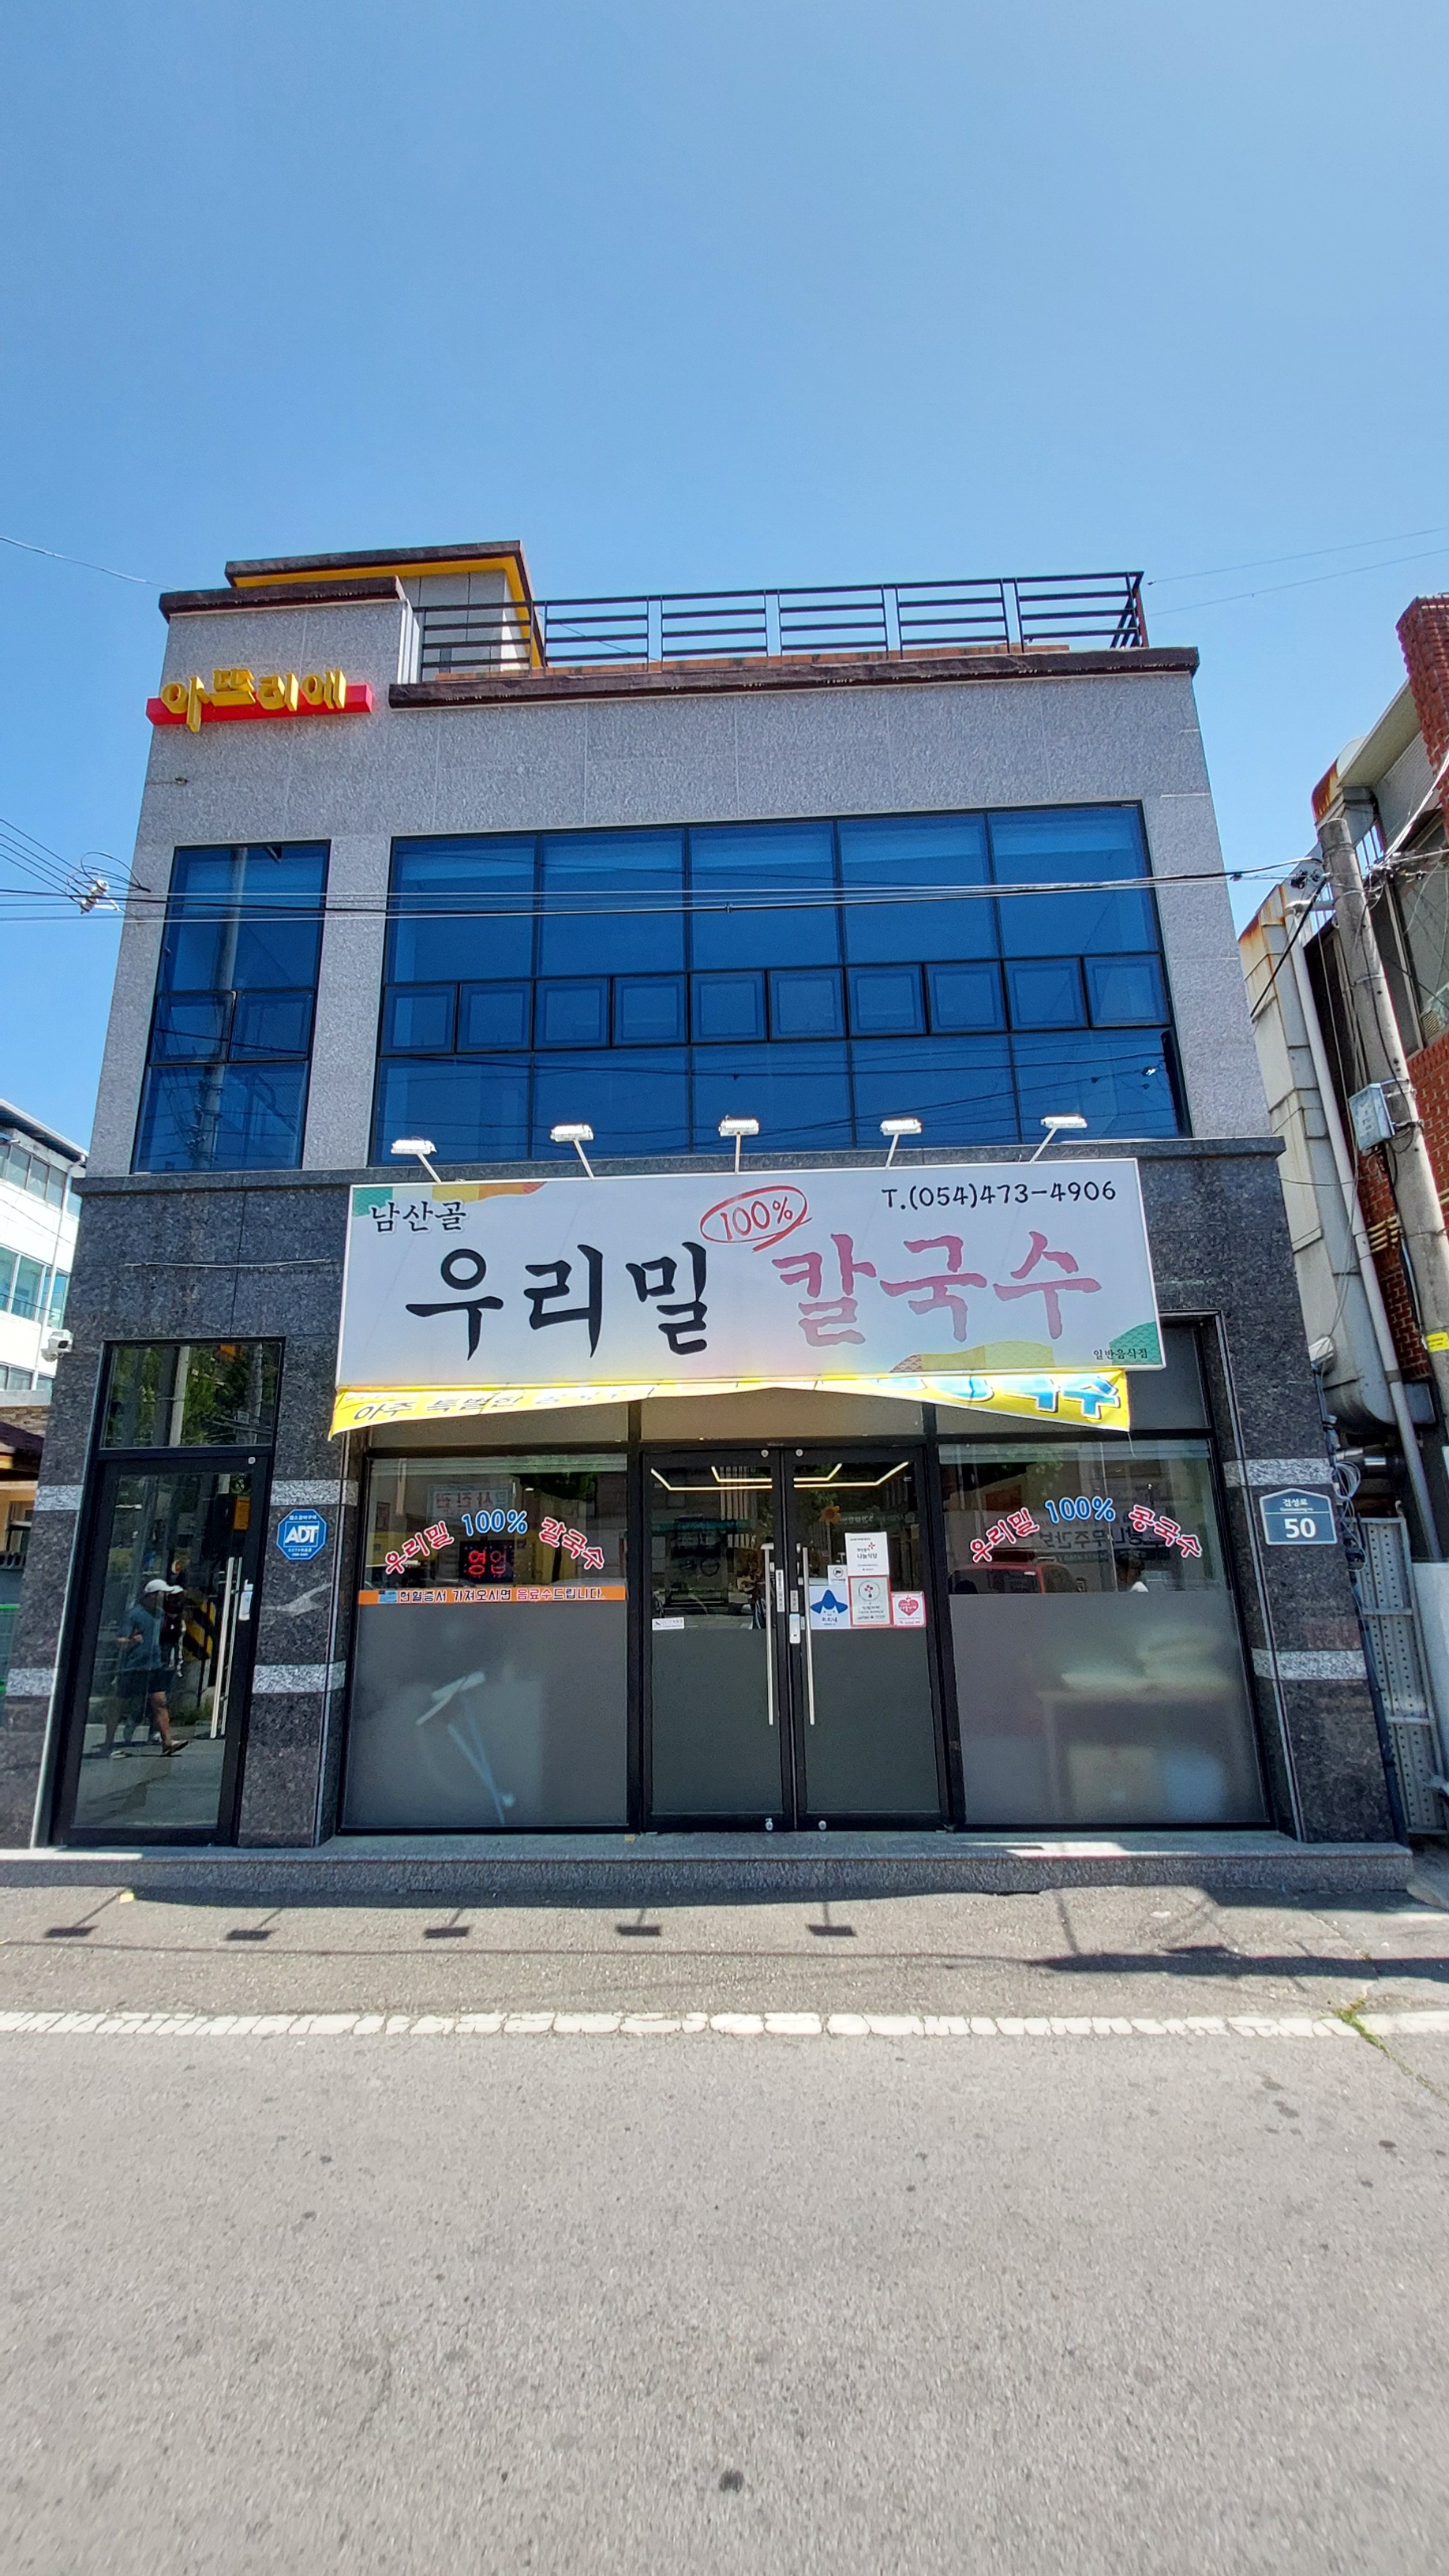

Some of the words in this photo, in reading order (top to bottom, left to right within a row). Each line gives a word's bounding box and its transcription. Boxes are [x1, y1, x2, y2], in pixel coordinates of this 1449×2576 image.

[881, 1180, 1117, 1211] T.(054)473-4906
[371, 1200, 467, 1233] 남산골
[720, 1196, 793, 1241] 100%
[405, 1241, 709, 1361] 우리밀
[771, 1230, 1103, 1347] 칼국수
[1093, 1348, 1148, 1360] 일반음식점
[354, 1402, 417, 1420] 아주
[284, 1526, 319, 1543] ADT
[385, 1520, 455, 1575] 우리밀
[462, 1509, 528, 1537] 100%
[538, 1516, 605, 1571] 칼국수
[970, 1507, 1040, 1563] 우리밀
[1045, 1496, 1116, 1524] 100%
[1129, 1505, 1203, 1559] 콩국수
[1284, 1518, 1316, 1538] 50
[400, 1590, 447, 1603] 헌혈증서
[453, 1589, 511, 1602] 가져오시면
